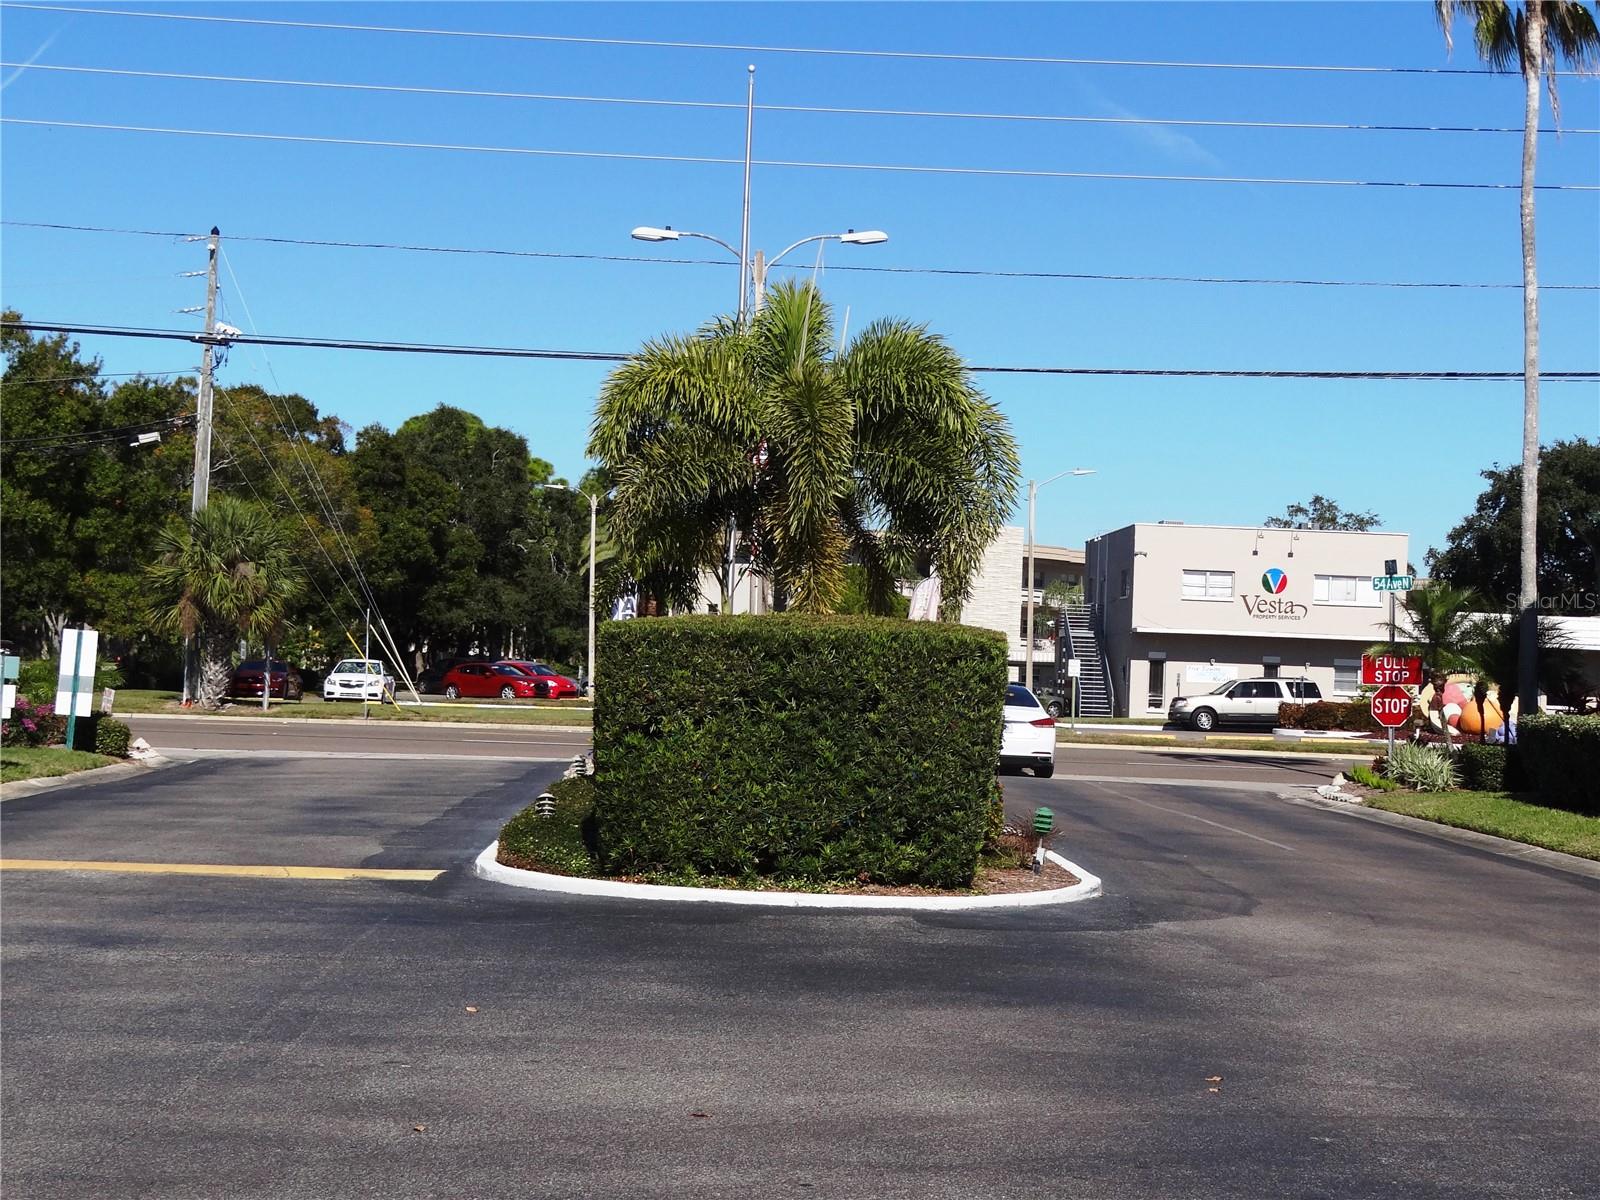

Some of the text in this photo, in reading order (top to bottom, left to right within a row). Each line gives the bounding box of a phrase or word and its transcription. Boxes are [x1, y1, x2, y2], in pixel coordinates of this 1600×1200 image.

[1374, 577, 1409, 590] 54 Ave N
[1240, 594, 1308, 618] Vesta
[1375, 656, 1409, 669] FULL
[1375, 670, 1409, 682] STOP
[1374, 699, 1409, 714] STOP
